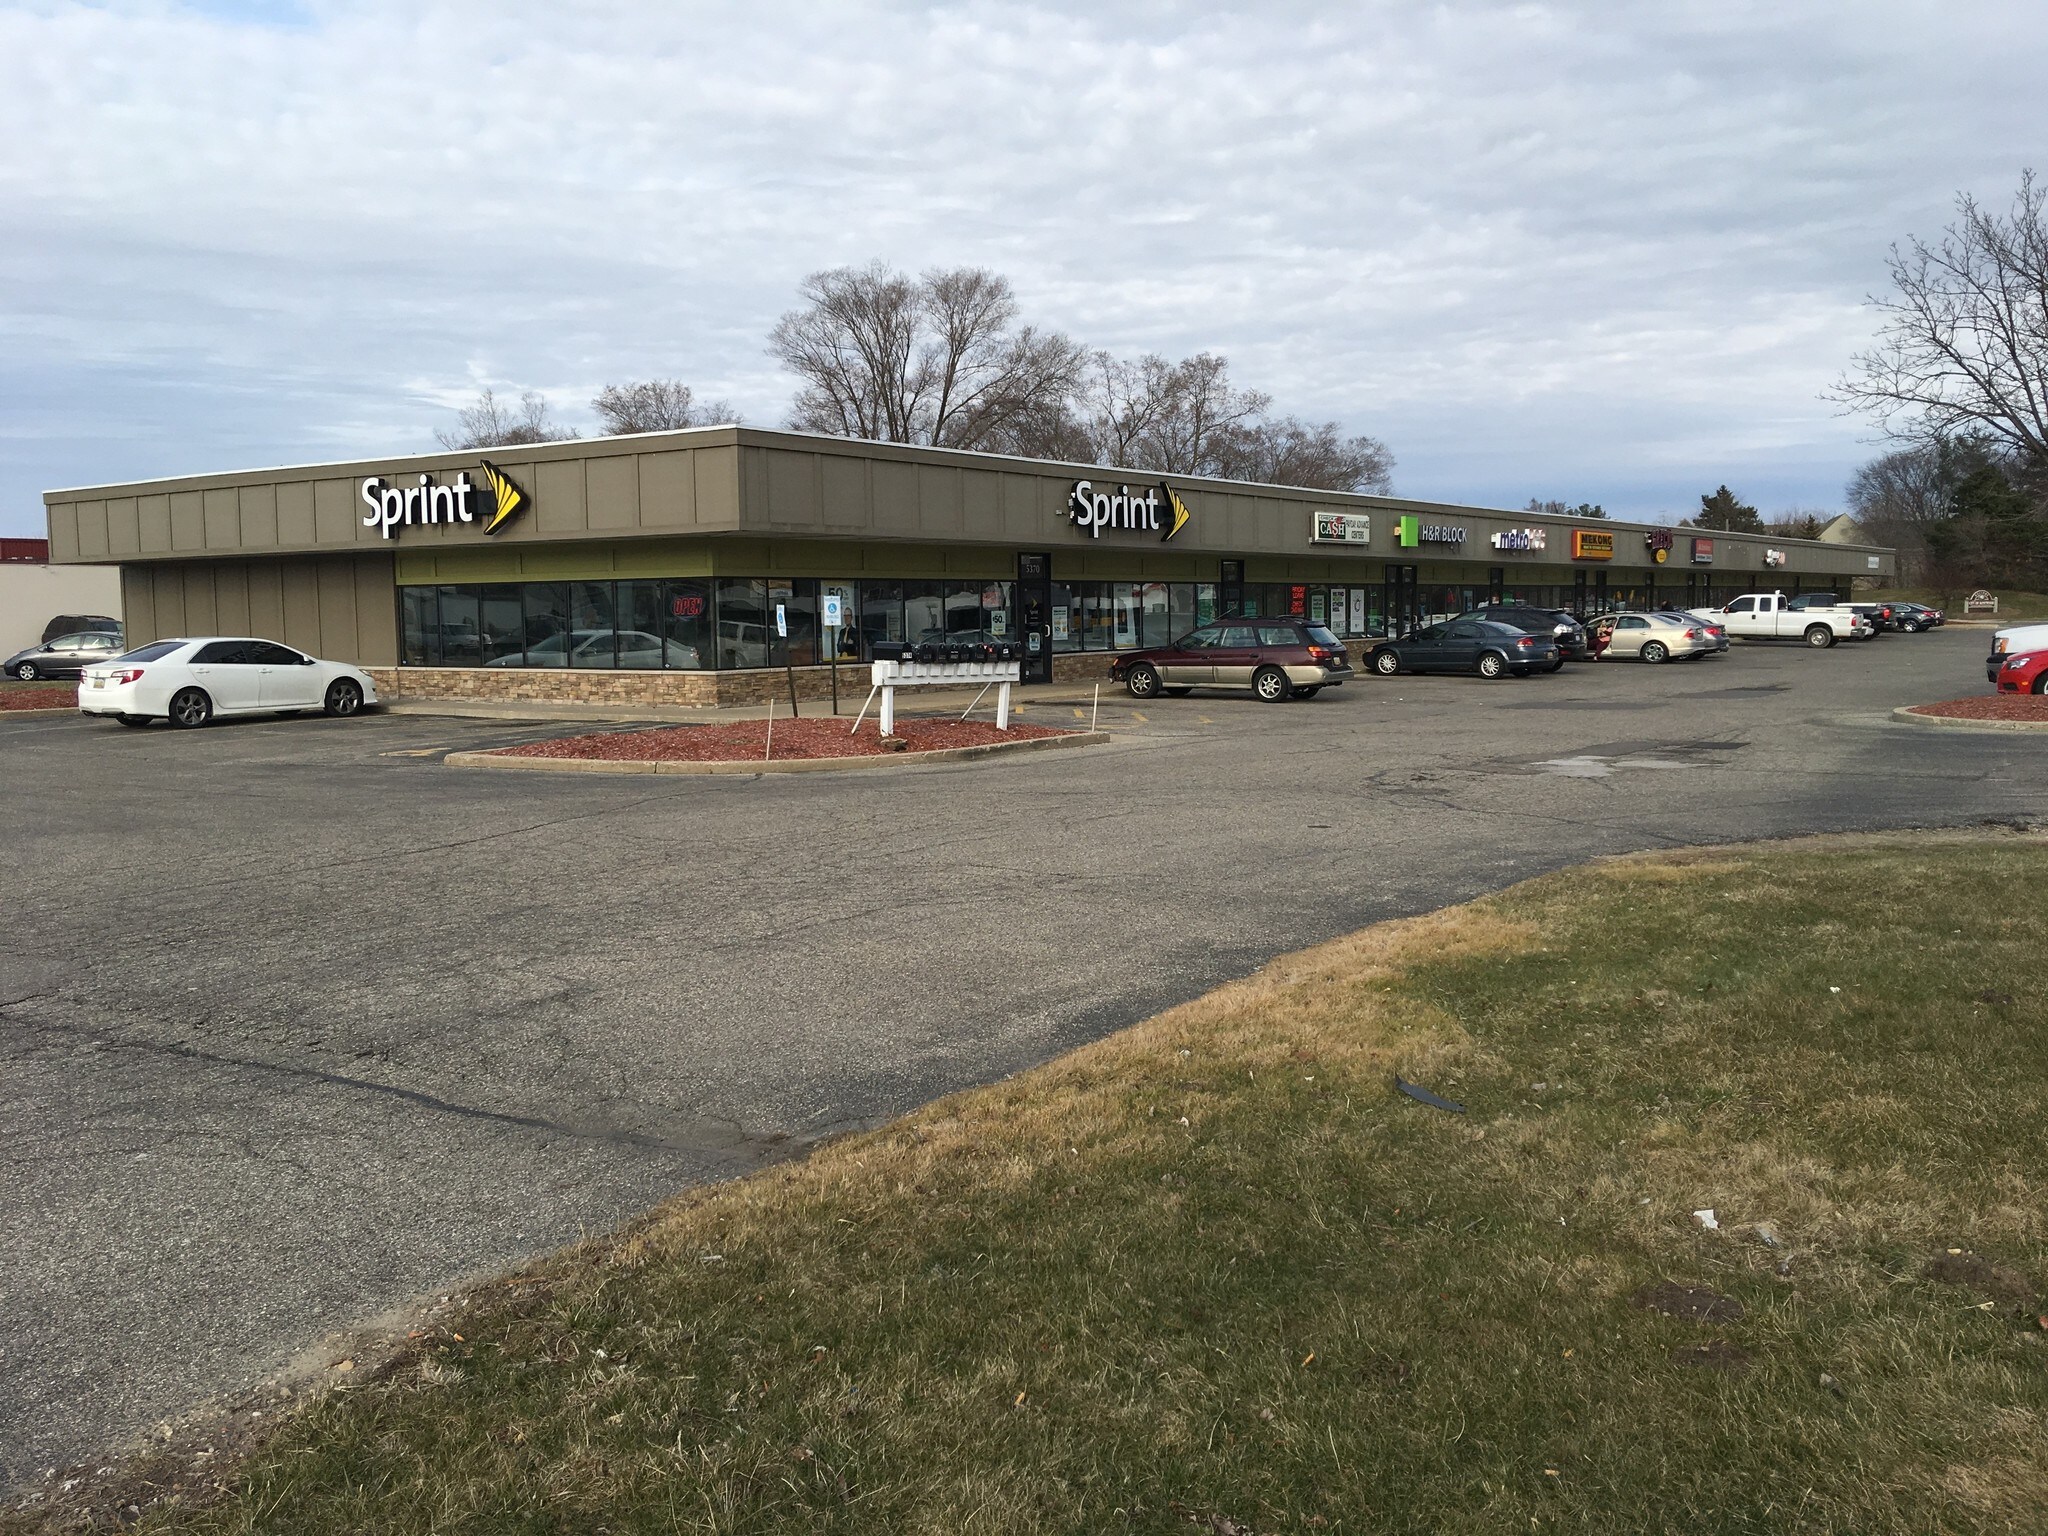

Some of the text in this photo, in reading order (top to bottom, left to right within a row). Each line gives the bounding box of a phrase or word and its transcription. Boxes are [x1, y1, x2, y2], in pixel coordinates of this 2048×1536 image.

[361, 472, 473, 539] Sprint
[1076, 480, 1160, 539] Sprint
[1422, 525, 1467, 543] H&R BLOCK
[1581, 534, 1612, 545] MEKONG
[1025, 564, 1040, 574] 5370
[673, 597, 702, 616] OPEN
